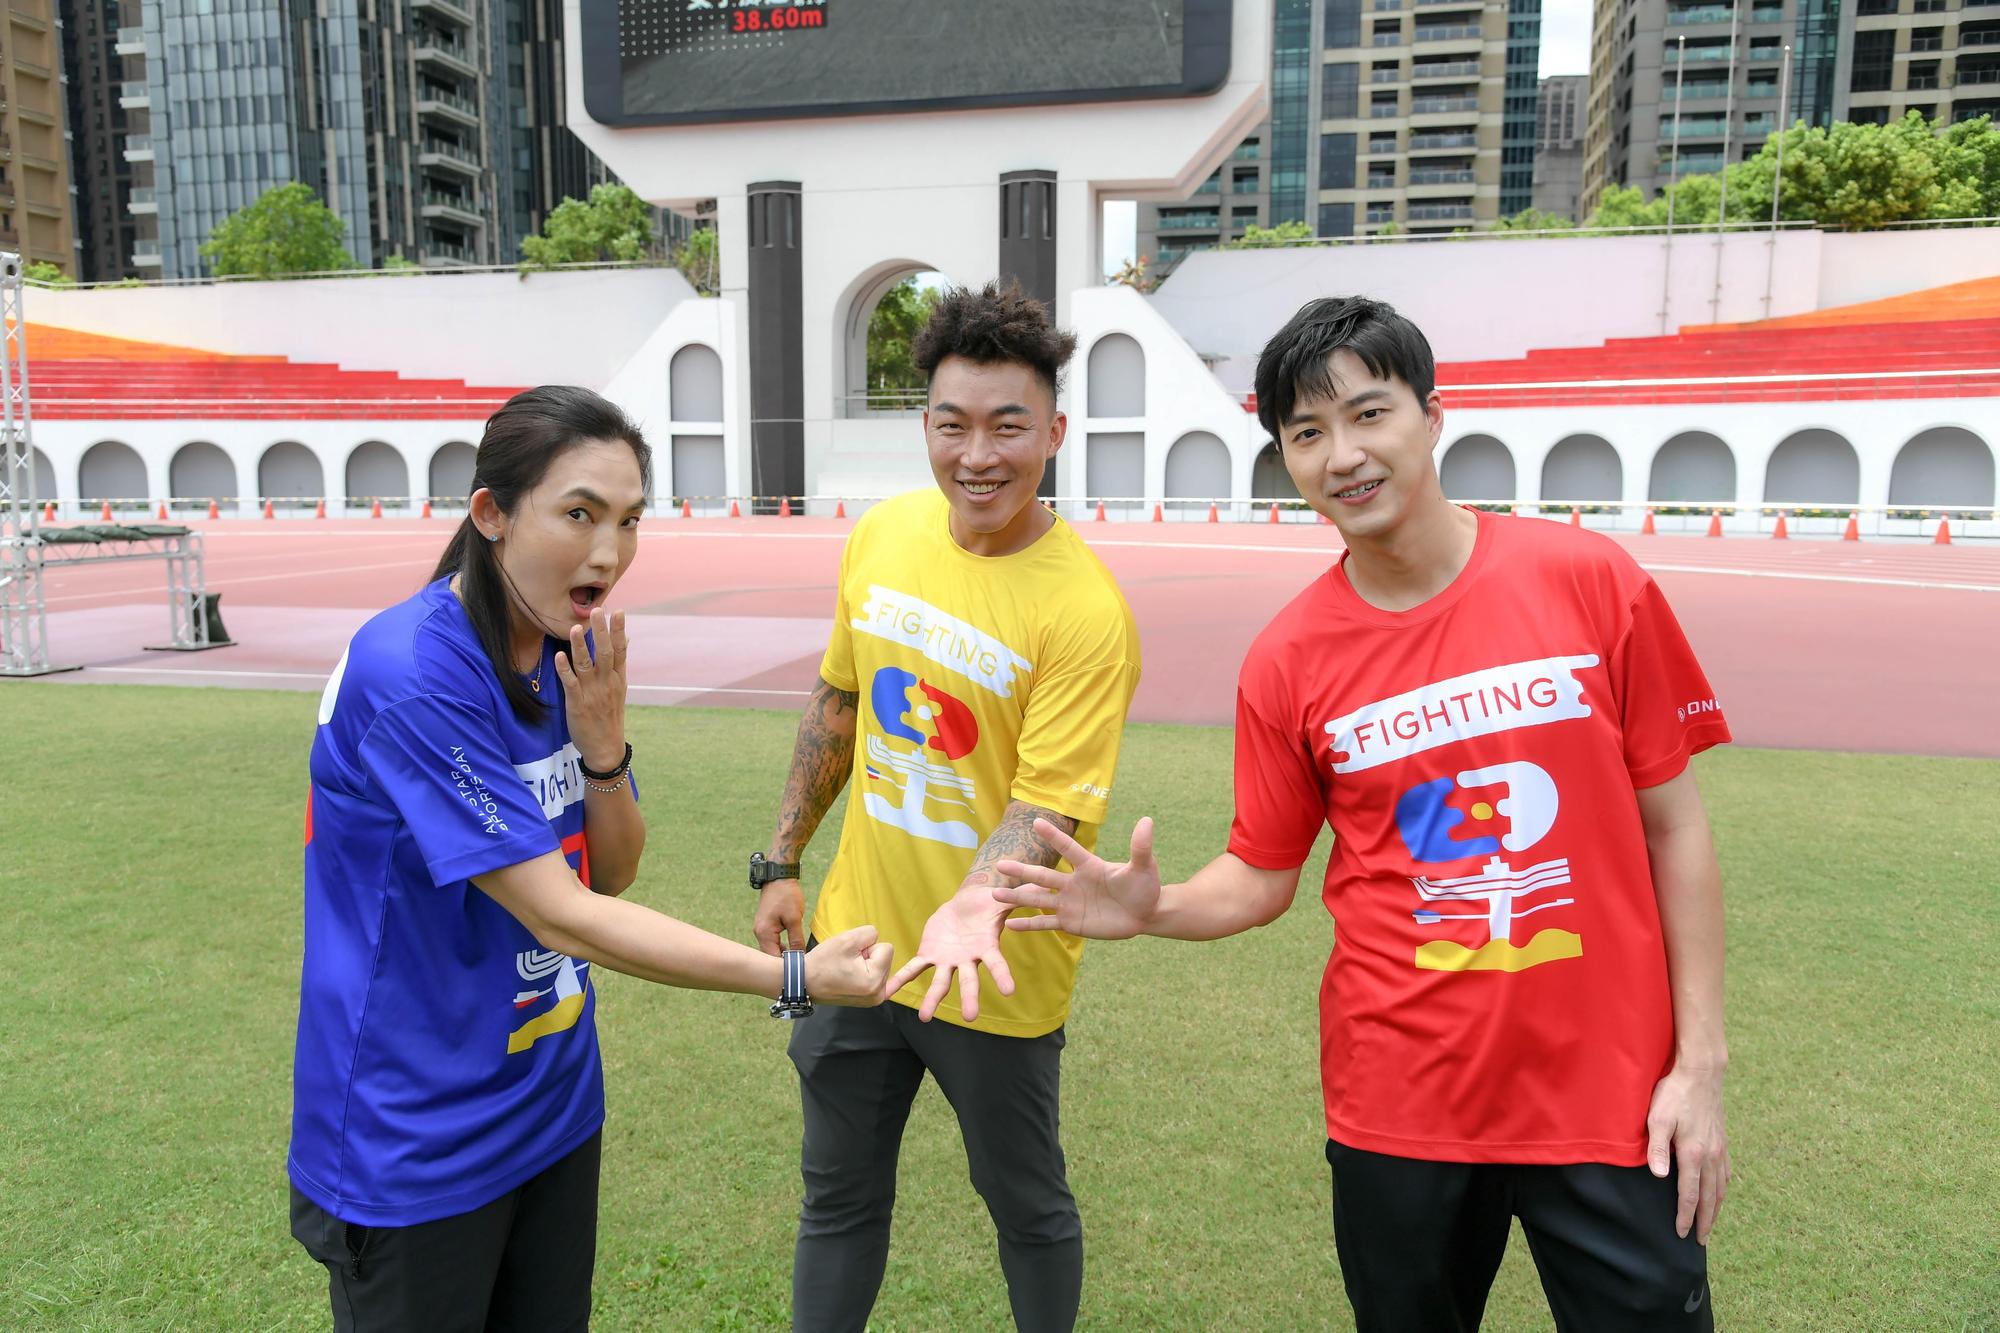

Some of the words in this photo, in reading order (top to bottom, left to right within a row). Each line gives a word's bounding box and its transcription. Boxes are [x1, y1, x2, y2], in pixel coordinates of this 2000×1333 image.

[733, 7, 822, 32] 38.60m
[876, 603, 998, 677] FIGHTING
[1353, 677, 1559, 754] FIGHTING
[450, 746, 472, 773] DAY
[470, 775, 509, 831] SPORTS
[1081, 783, 1113, 800] ONE
